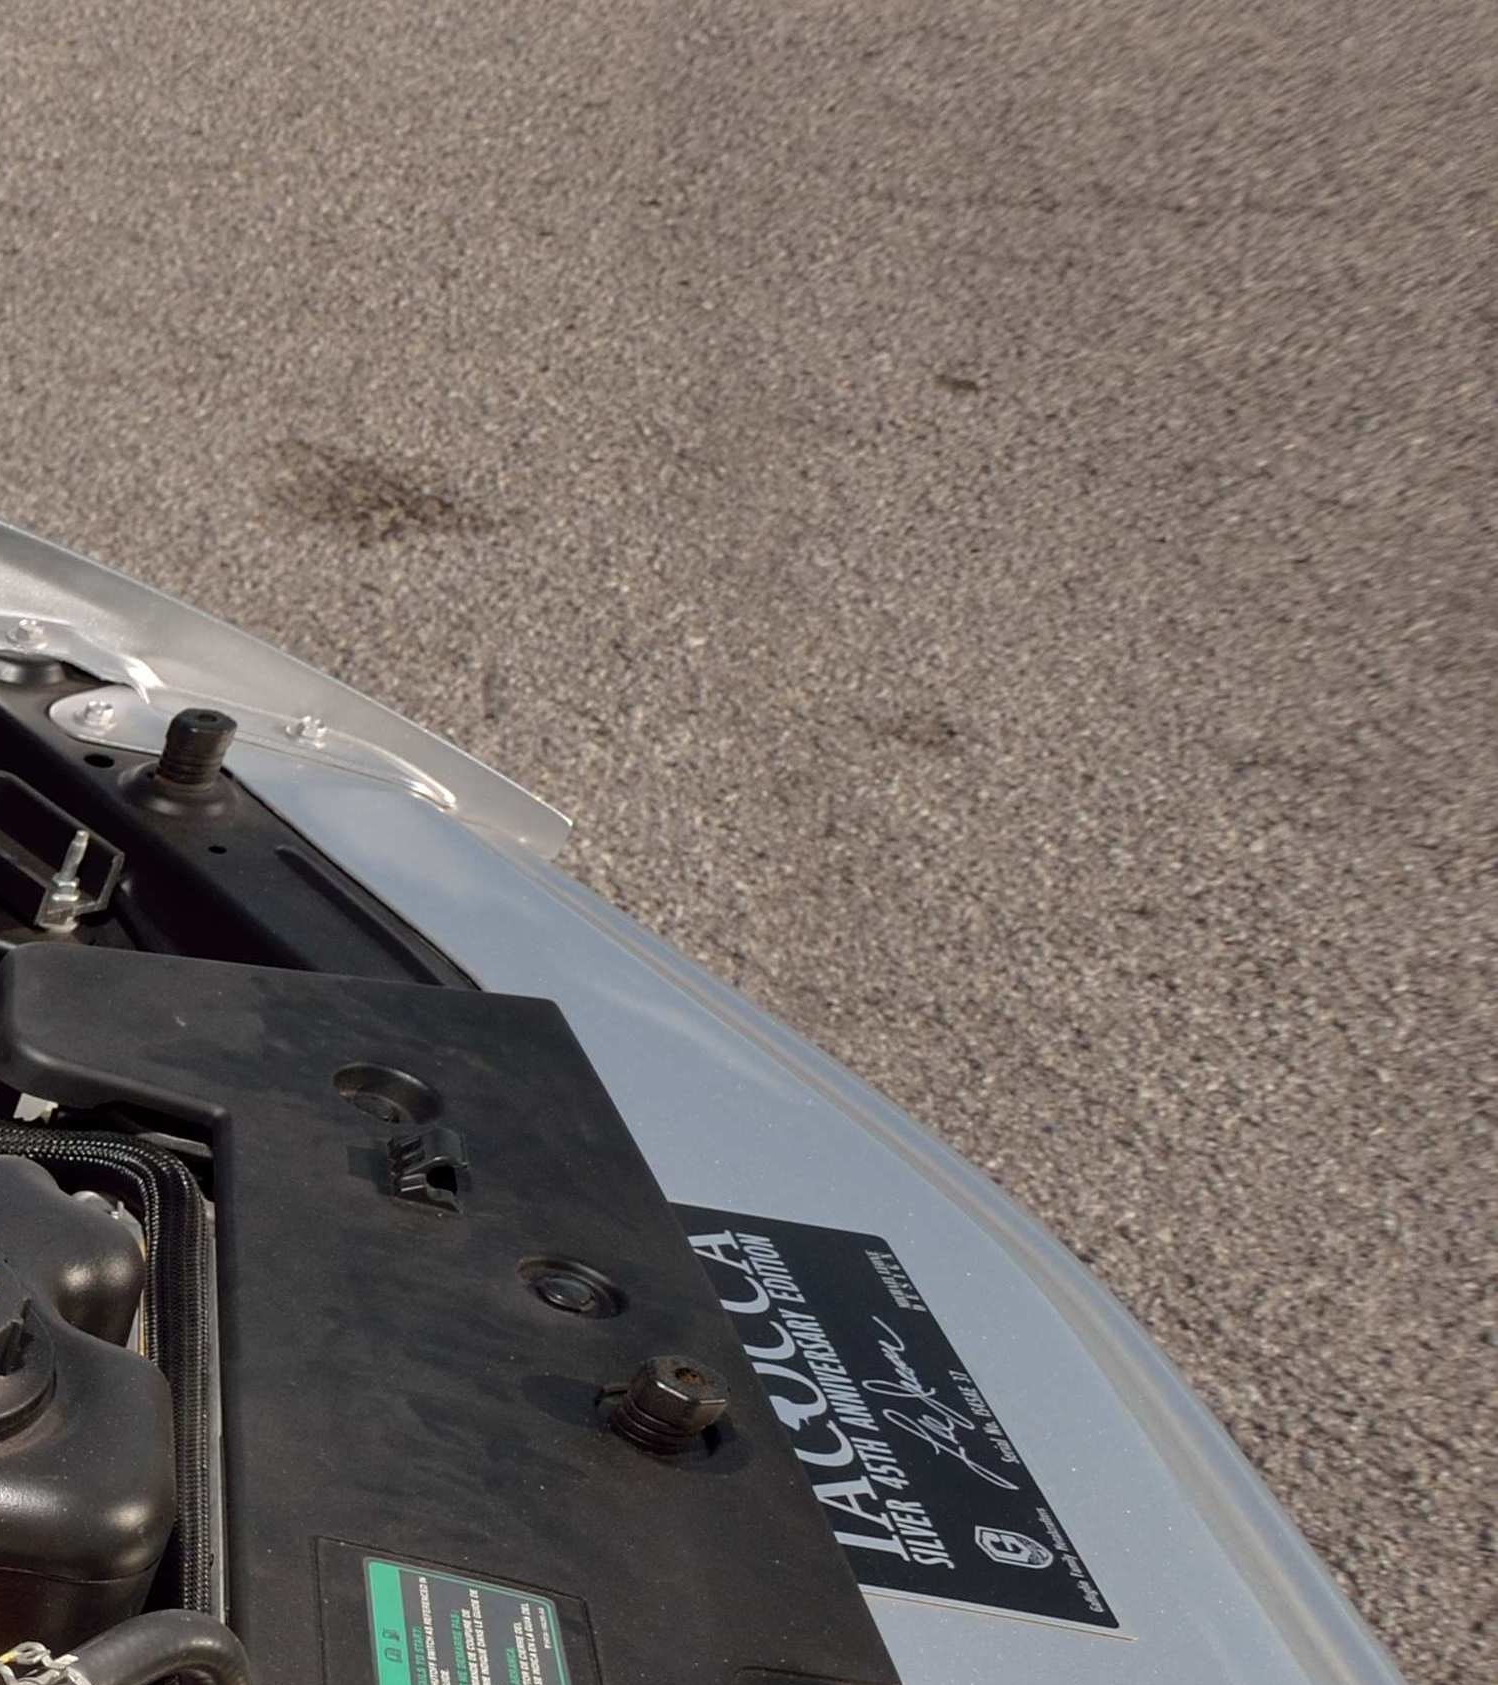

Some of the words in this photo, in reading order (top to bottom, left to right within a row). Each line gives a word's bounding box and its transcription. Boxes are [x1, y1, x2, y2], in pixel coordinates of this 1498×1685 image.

[733, 1231, 807, 1302] EDITION
[777, 1307, 880, 1430] ANNIVERSARY
[848, 1436, 914, 1491] 45TH
[878, 1494, 956, 1568] SILVER
